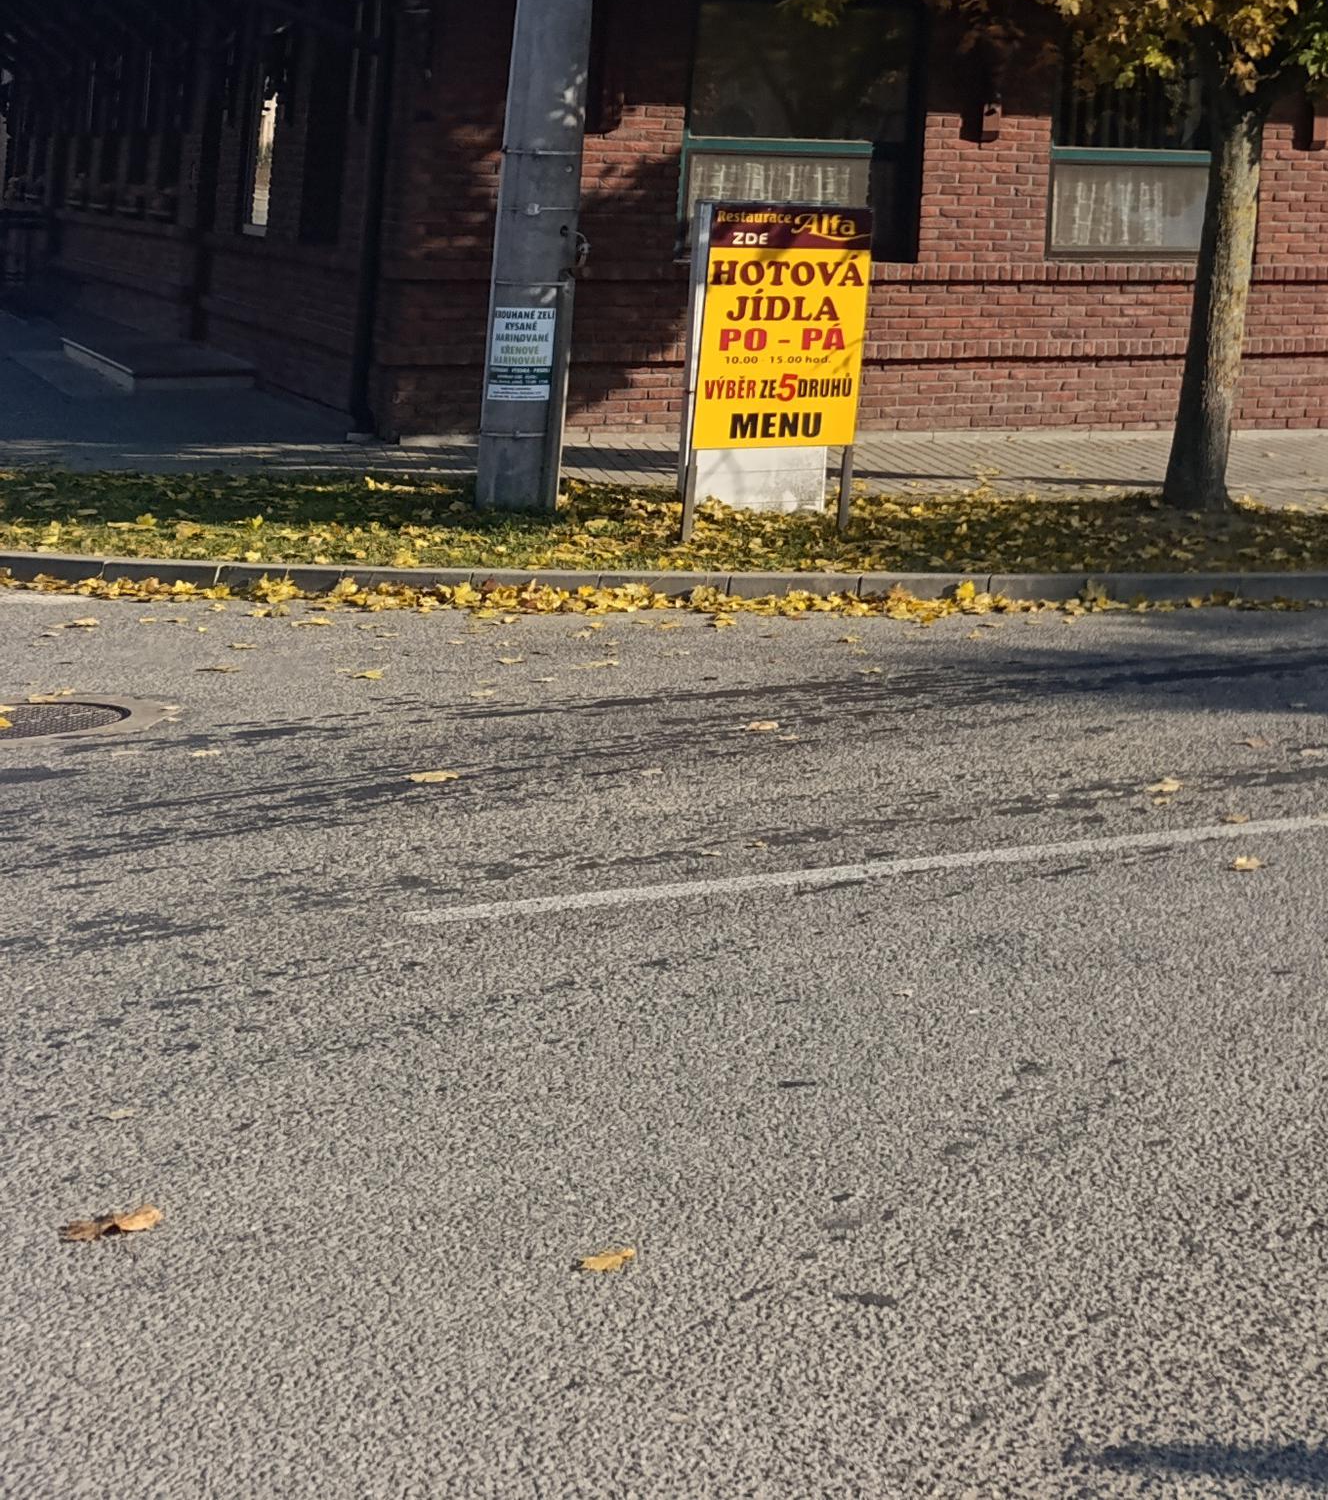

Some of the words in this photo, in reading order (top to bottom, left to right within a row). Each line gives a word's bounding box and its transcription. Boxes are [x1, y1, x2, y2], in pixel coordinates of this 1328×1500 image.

[717, 211, 792, 224] Restaurace
[791, 213, 858, 238] Alfa
[732, 232, 769, 245] ZDE
[710, 254, 865, 287] HOTOVÁ
[726, 289, 839, 322] JÍDLA
[505, 321, 538, 331] KYSANÉ
[719, 328, 767, 351] PO
[801, 324, 846, 350] PÁ
[725, 356, 758, 364] 10.00
[770, 356, 802, 364] 15.00
[704, 375, 757, 399] VÝBĚR
[759, 379, 777, 398] ZE
[775, 373, 798, 402] 5
[797, 373, 852, 398] DRUHŮ
[729, 412, 822, 439] MENU
